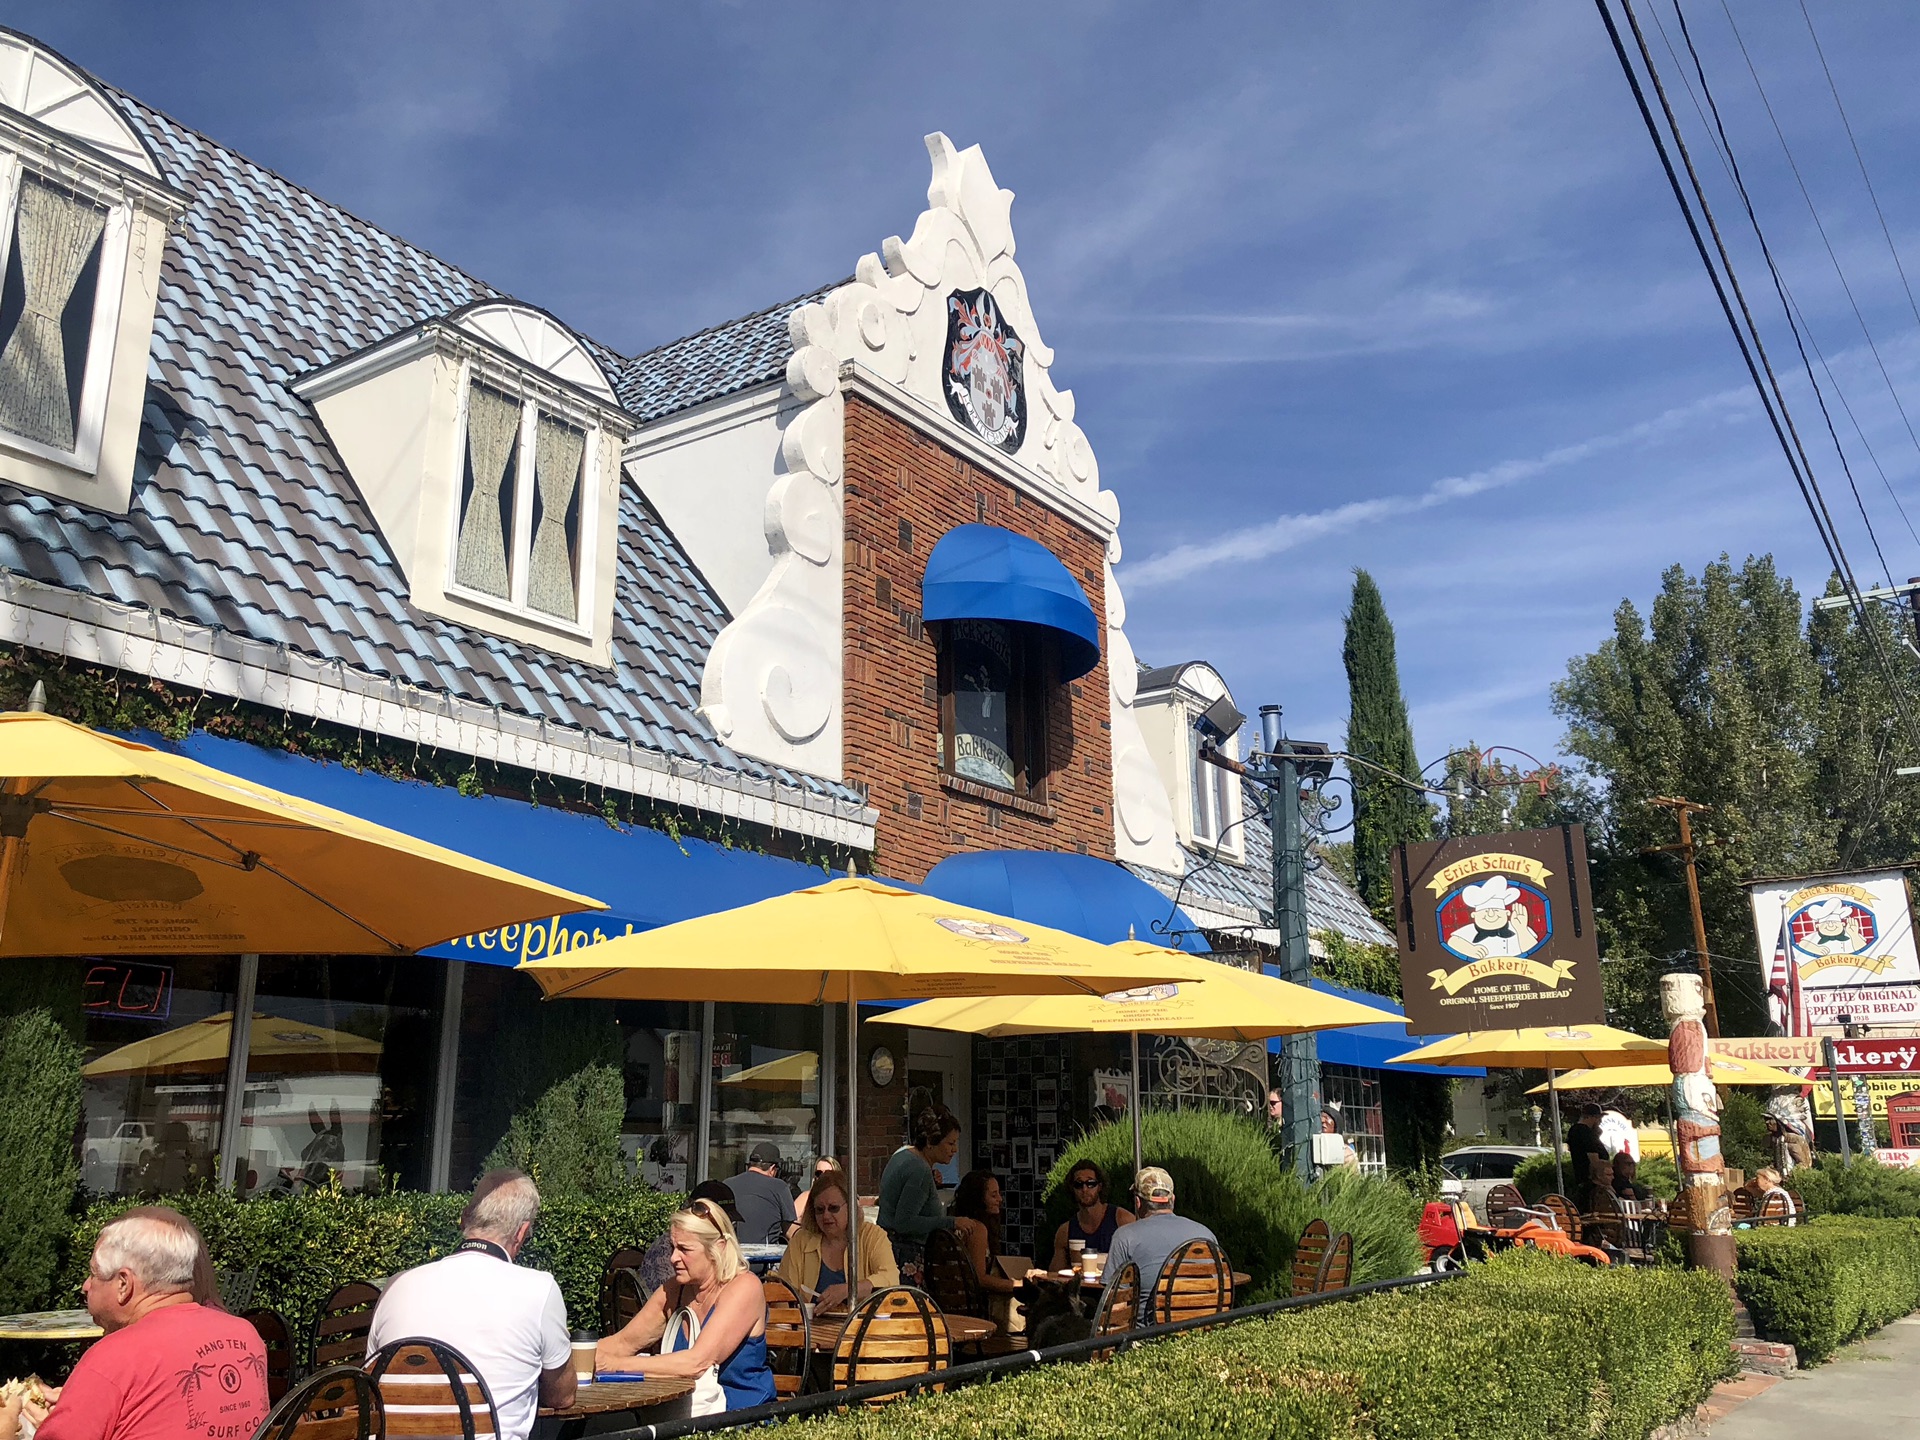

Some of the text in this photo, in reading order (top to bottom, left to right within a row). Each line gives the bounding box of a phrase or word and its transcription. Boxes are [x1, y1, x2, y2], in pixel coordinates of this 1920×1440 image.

[1443, 856, 1531, 882] Erick Schat's
[1799, 886, 1821, 900] Erick
[82, 966, 166, 1013] ELI
[1473, 983, 1531, 995] HOME OF THE
[1813, 993, 1828, 1003] OF
[1830, 991, 1857, 1002] THE
[1858, 989, 1917, 1001] ORIGINAL
[1439, 996, 1478, 1006] ORIGINAL
[1479, 992, 1539, 1004] SHEEPHERDER
[1806, 1003, 1870, 1016] EPHERDER
[1834, 1045, 1917, 1070] kkerÿ
[1866, 1082, 1897, 1091] obile
[1877, 1152, 1910, 1161] CARS
[461, 1241, 488, 1250] Canon
[196, 1339, 247, 1359] HANG TEN
[219, 1403, 237, 1414] SINCE
[207, 1424, 240, 1438] SURF
